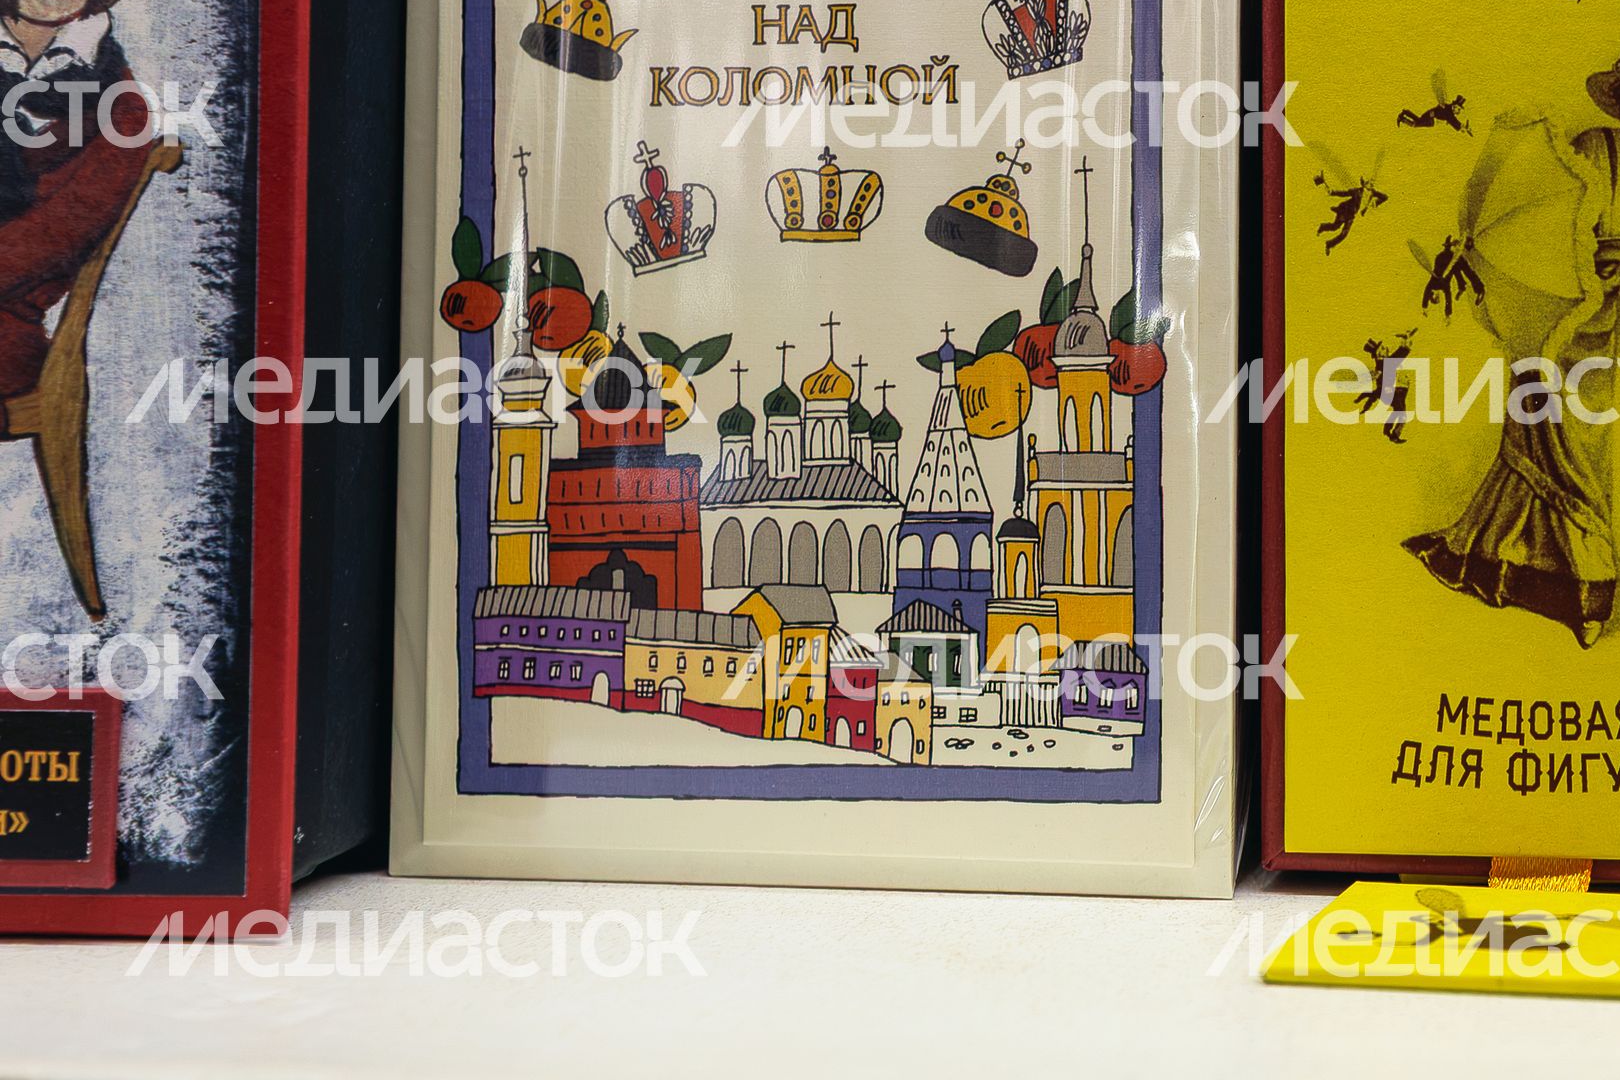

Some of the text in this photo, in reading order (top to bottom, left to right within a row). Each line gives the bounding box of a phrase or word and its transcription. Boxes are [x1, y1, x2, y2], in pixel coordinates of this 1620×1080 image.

[751, 3, 859, 53] НАД
[649, 55, 960, 107] КОЛОМНОЙ
[1391, 740, 1484, 789] ДЛЯ
